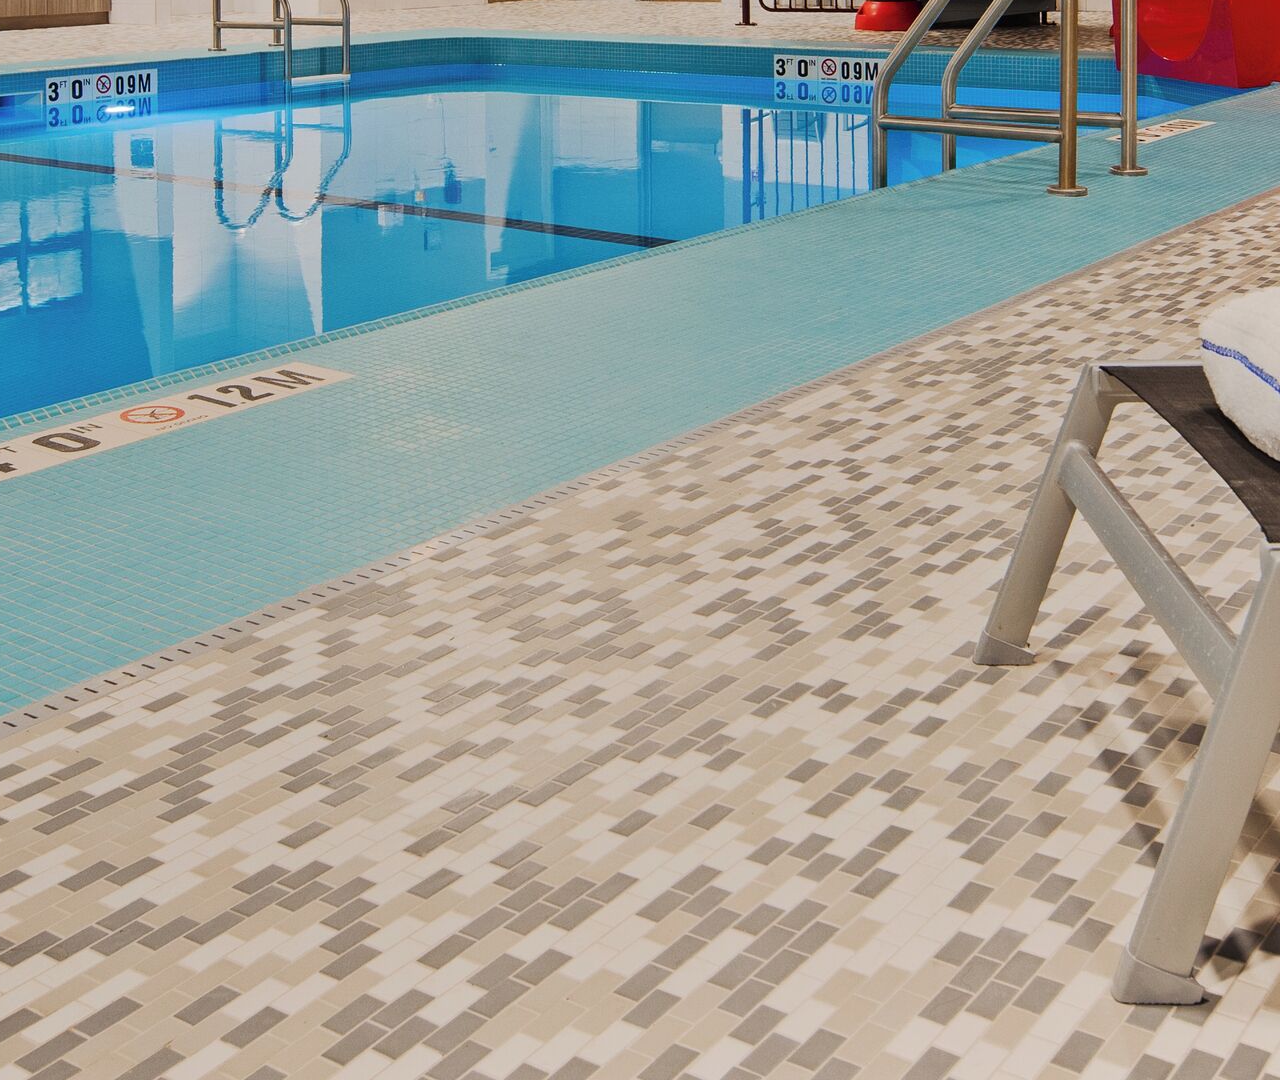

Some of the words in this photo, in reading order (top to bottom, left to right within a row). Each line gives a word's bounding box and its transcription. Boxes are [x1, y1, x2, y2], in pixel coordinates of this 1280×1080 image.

[776, 59, 786, 76] 3
[798, 60, 808, 77] 0
[865, 63, 878, 80] M
[48, 82, 59, 101] 3
[72, 80, 82, 99] 0
[139, 73, 151, 92] M
[32, 432, 101, 453] 0
[70, 423, 102, 434] IN
[252, 369, 326, 390] M
